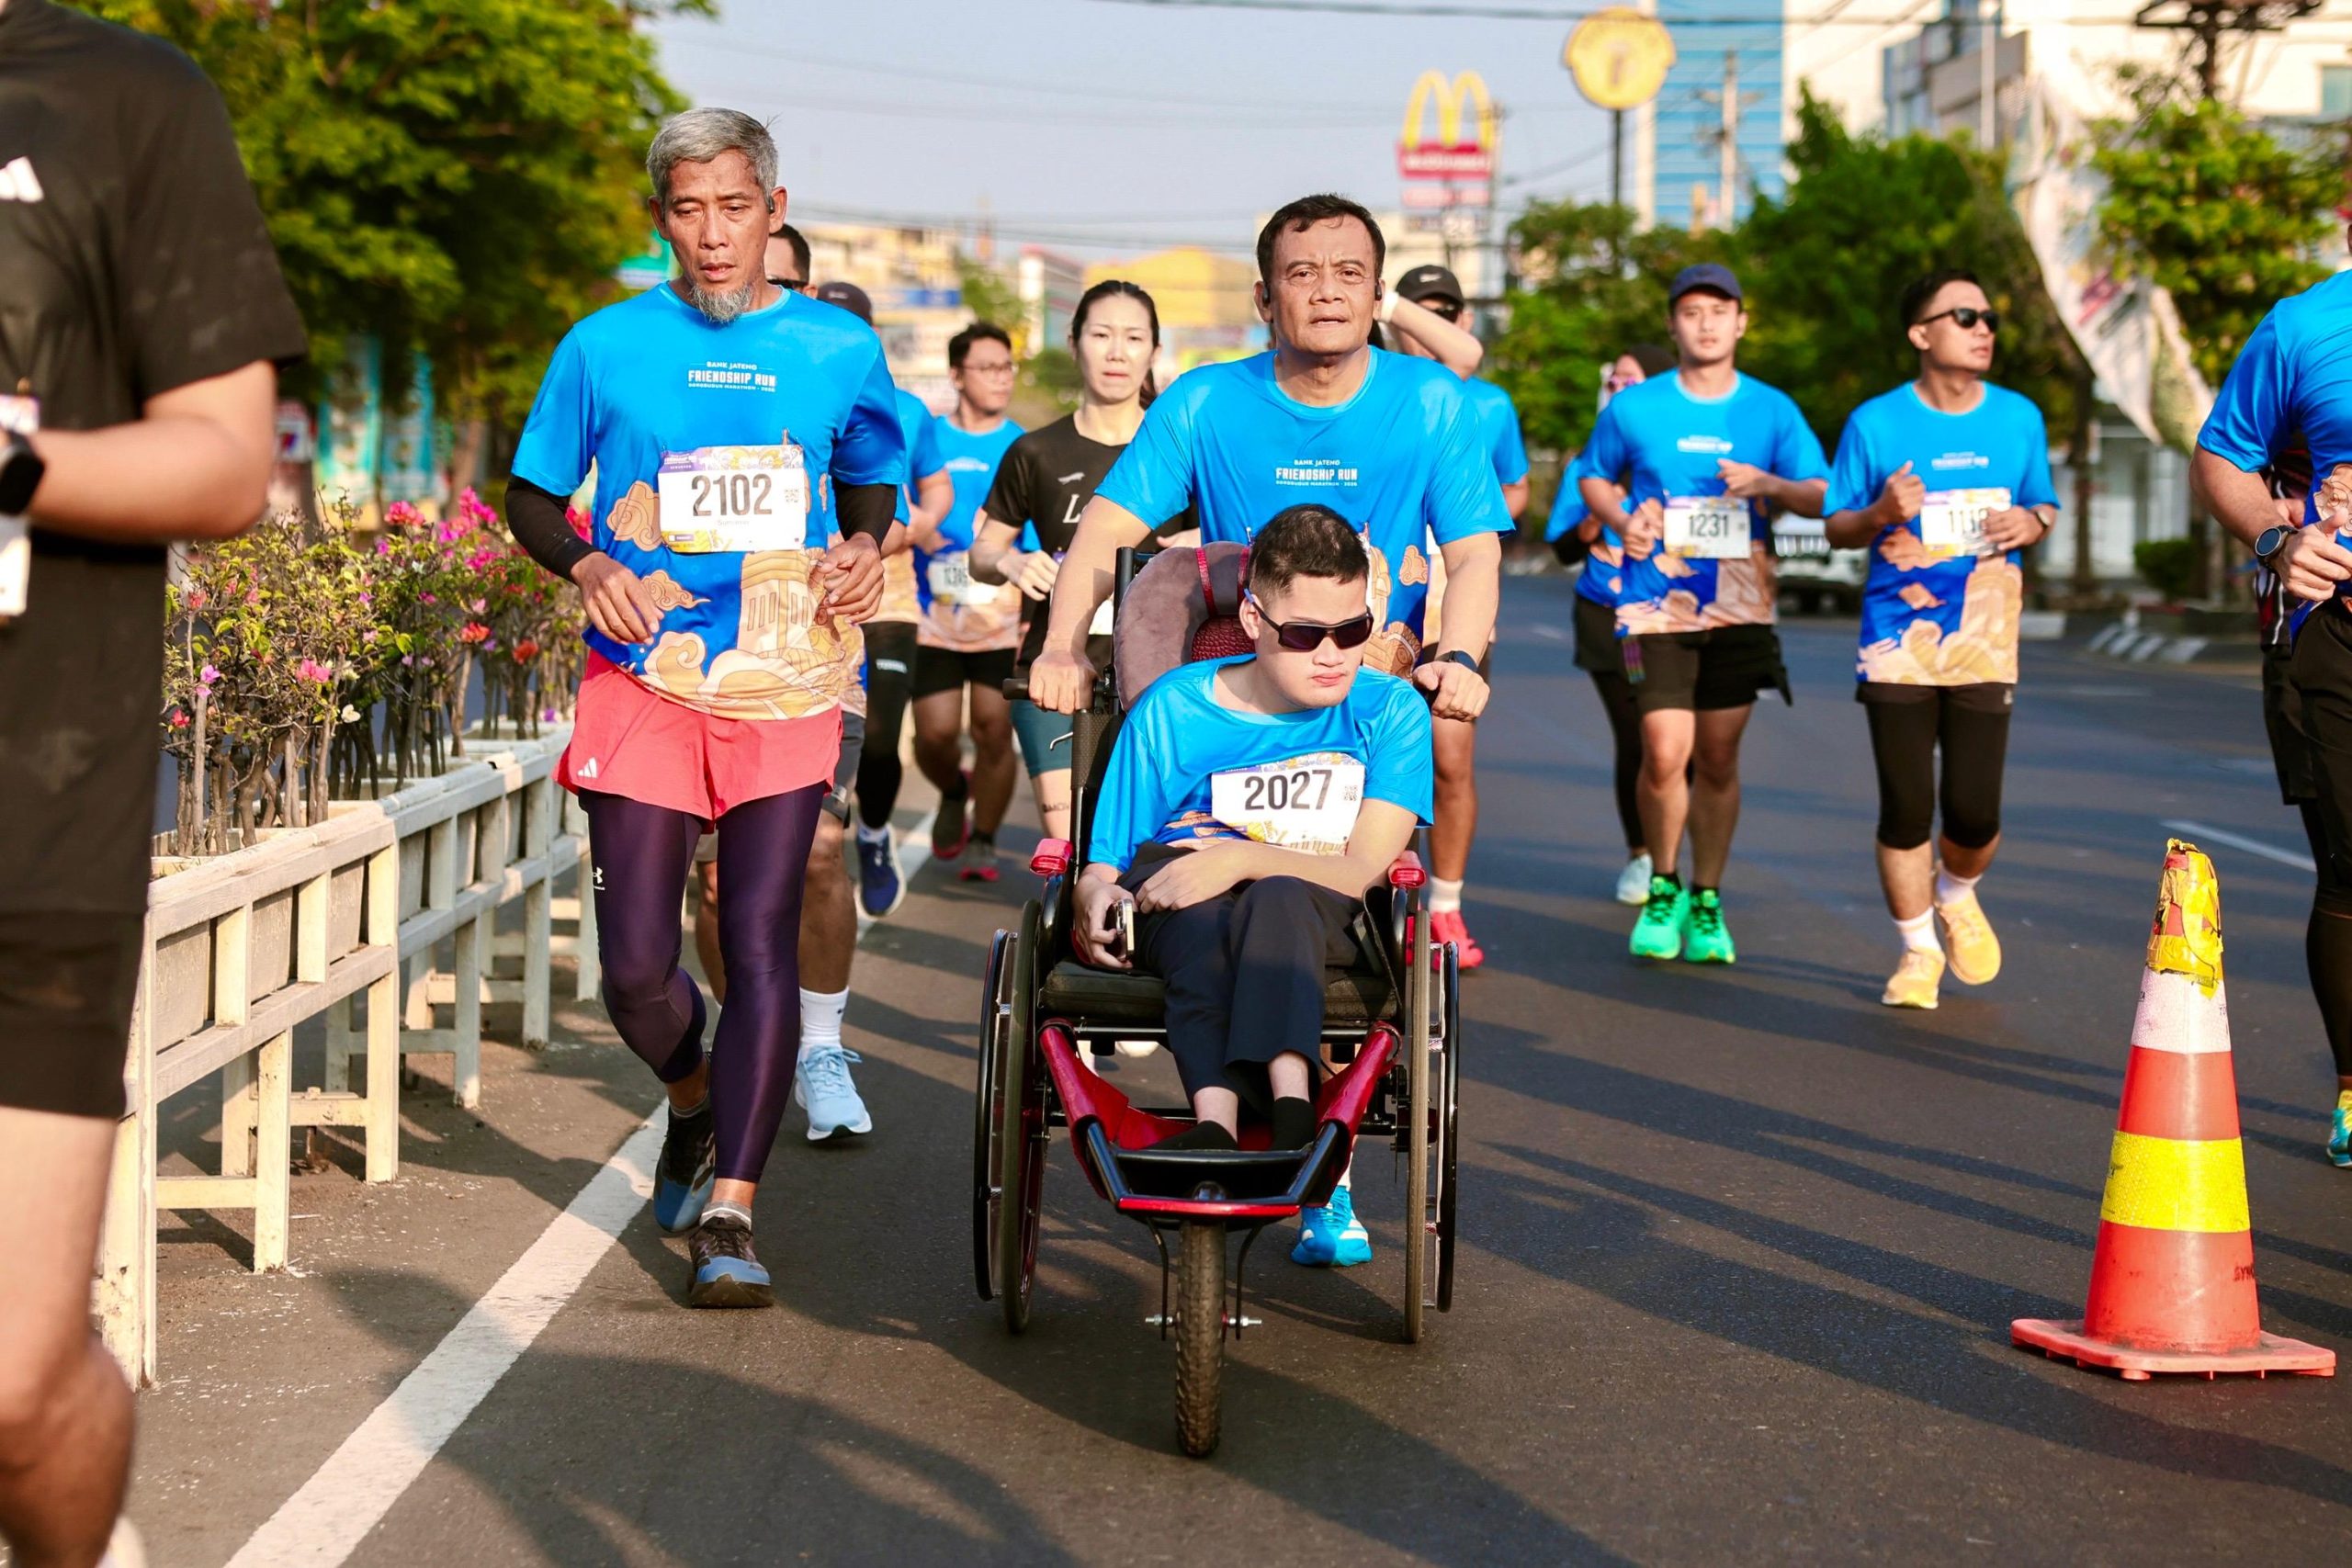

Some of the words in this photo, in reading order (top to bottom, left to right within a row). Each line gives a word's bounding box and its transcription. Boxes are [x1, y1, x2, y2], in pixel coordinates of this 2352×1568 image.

[729, 362, 758, 370] JATENG
[688, 369, 752, 384] FRIENDSHIP
[754, 373, 776, 387] RUN
[1275, 467, 1335, 480] FRIENDSHIP
[1338, 468, 1358, 480] RUN
[691, 473, 773, 517] 2102
[1689, 513, 1728, 537] 1231
[1244, 769, 1332, 810] 2027
